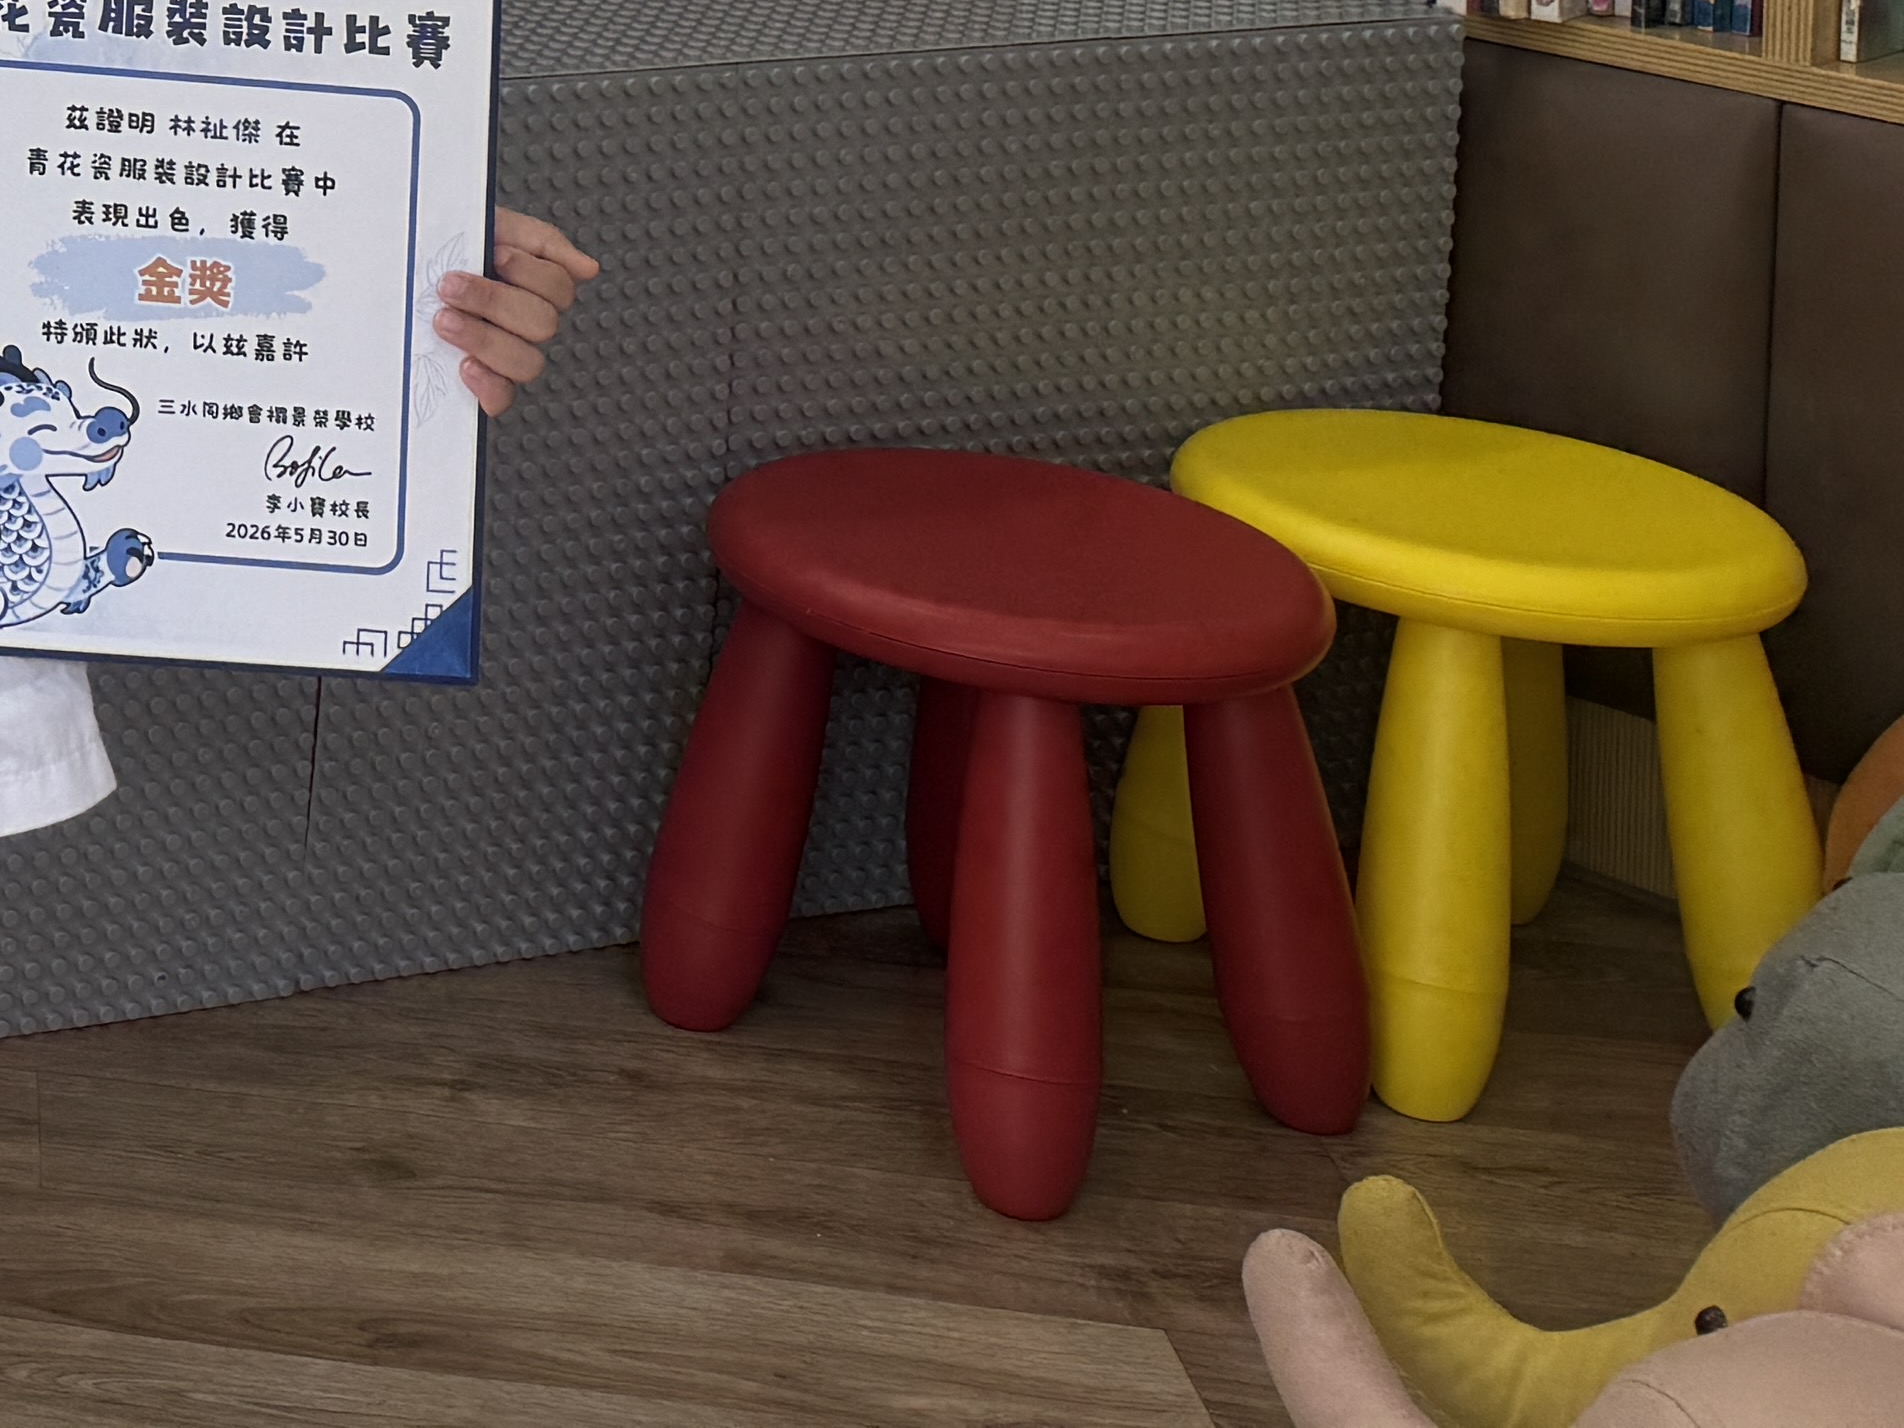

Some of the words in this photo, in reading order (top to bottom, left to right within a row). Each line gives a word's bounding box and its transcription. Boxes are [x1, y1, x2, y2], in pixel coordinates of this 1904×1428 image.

[275, 121, 302, 147] 在
[26, 147, 337, 198] 青花瓷服裝設計比賽中
[229, 211, 291, 242] 獲得
[137, 255, 234, 309] 金獎
[224, 521, 369, 548] 2026年5月30日
